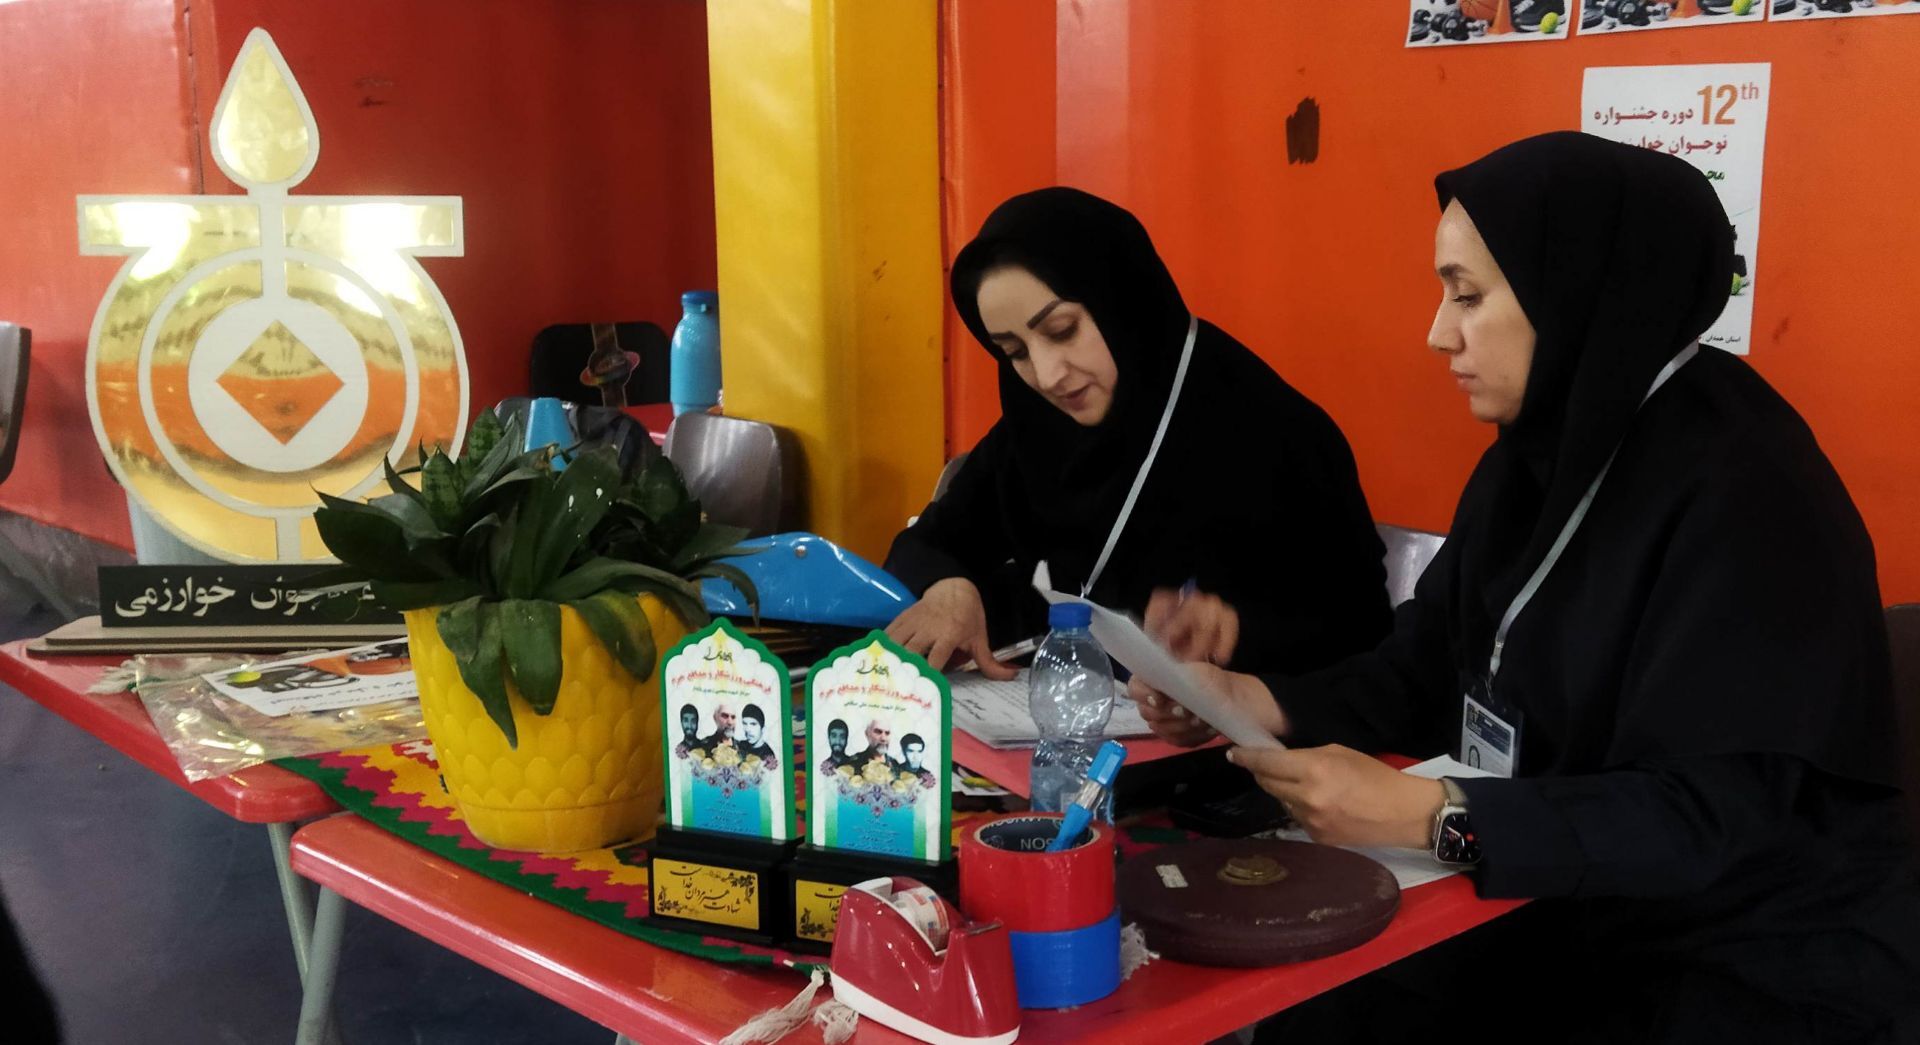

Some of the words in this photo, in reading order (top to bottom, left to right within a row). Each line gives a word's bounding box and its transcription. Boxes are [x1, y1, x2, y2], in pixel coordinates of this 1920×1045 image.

[1594, 106, 1658, 125] جشنواره
[1661, 107, 1694, 125] دوره
[1667, 134, 1728, 156] نوجوان
[114, 576, 236, 617] خوارزمی
